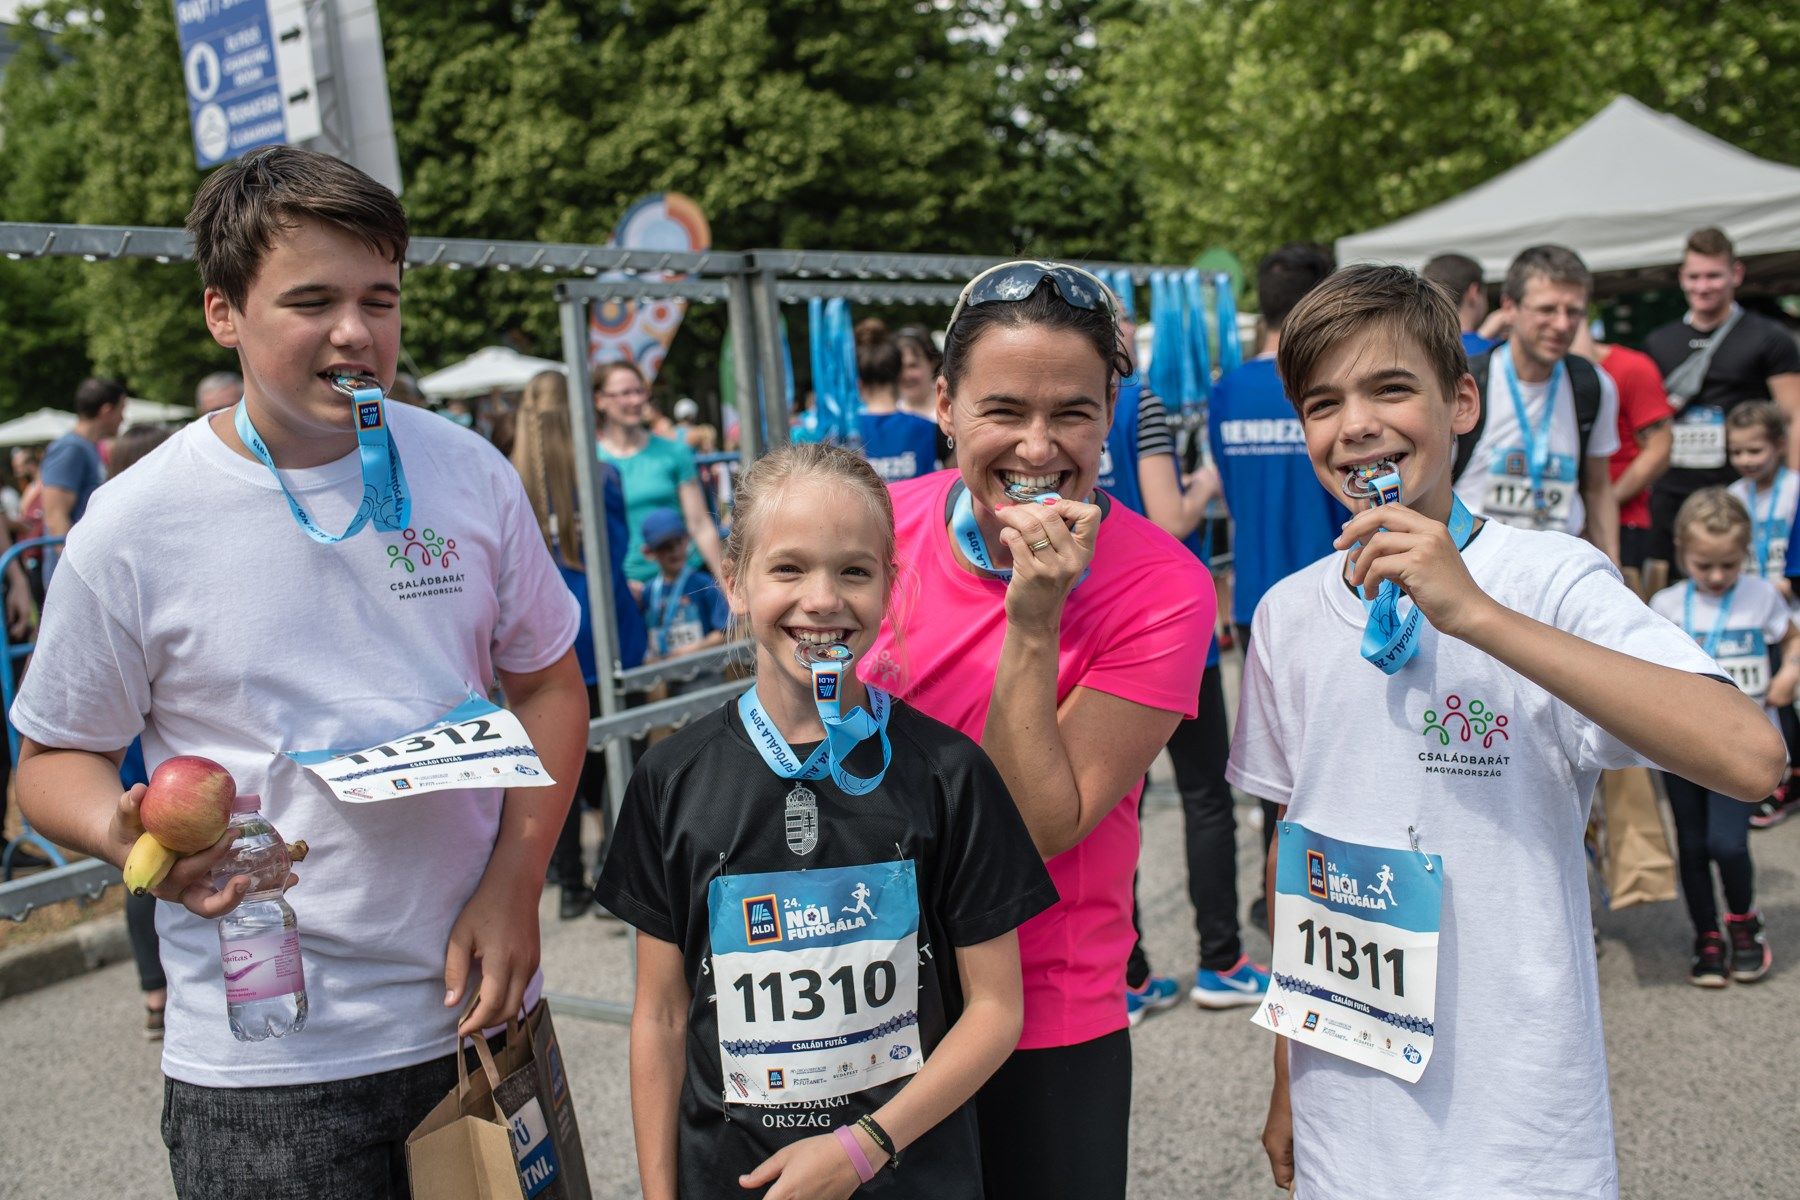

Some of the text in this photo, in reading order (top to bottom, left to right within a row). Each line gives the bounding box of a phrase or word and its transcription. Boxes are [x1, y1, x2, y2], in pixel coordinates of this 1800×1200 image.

[389, 573, 466, 592] CSALÁDBARÁT
[399, 586, 464, 601] MAGYARORSZÁG
[337, 719, 503, 765] 11312
[749, 708, 797, 774] FUTÓGÁLA 2019
[1418, 752, 1510, 765] CSALÁDBARÁT
[1425, 766, 1502, 778] MAGYARORSZÁG
[1327, 862, 1339, 873] 24.
[1311, 877, 1324, 888] ALDI
[1328, 873, 1359, 896] NŐI
[783, 898, 801, 909] 24.
[1330, 893, 1387, 910] FUTÓGÁLA
[785, 904, 830, 929] NŐI
[752, 924, 775, 936] ALDI
[787, 916, 867, 941] FUTÓGÁLA
[1298, 918, 1405, 998] 11311
[732, 960, 897, 1023] 11310
[1331, 994, 1370, 1013] CSALÁDI FUTÁS
[791, 1036, 848, 1051] CSALÁDI FUTÁS
[761, 1112, 831, 1128] ORSZÁG
